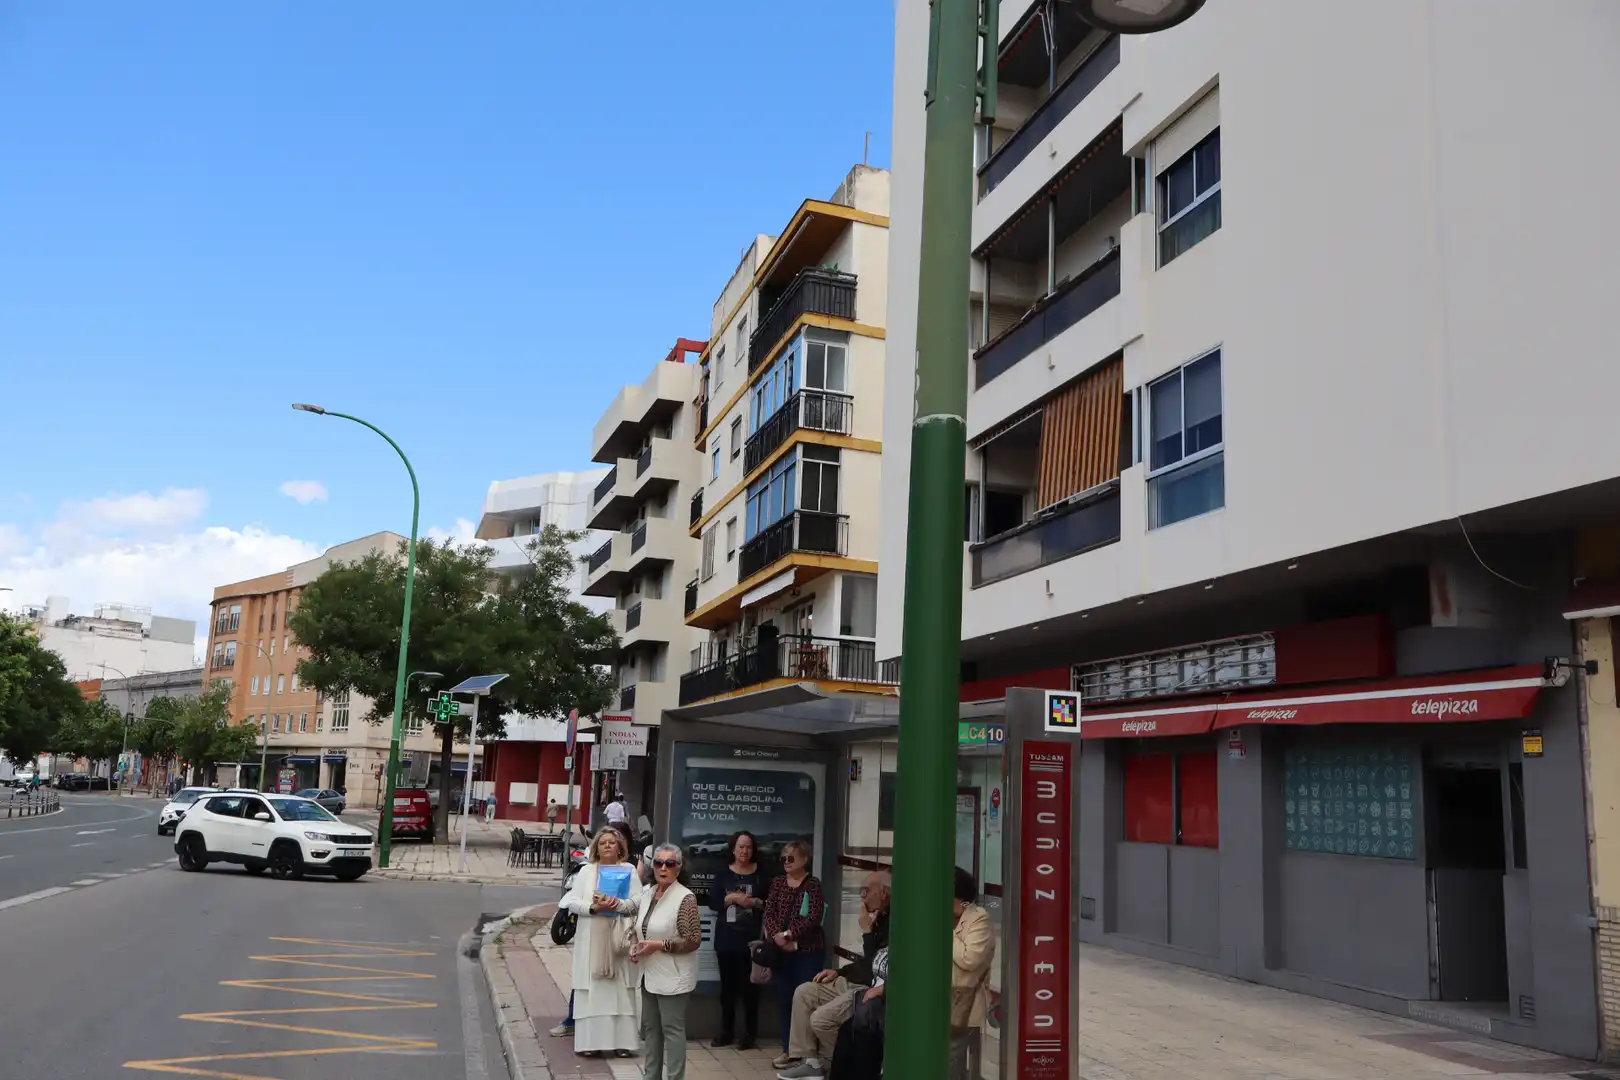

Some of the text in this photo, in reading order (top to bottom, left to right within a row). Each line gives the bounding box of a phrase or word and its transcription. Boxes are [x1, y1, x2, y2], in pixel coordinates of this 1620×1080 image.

[1411, 698, 1478, 720] telepizza
[1247, 709, 1298, 723] telepizza
[1122, 720, 1157, 735] telepizza
[969, 727, 986, 740] C4
[987, 727, 1004, 742] 10
[692, 783, 776, 793] QUE EL PRECIO
[710, 793, 725, 801] LA
[727, 794, 784, 803] GASOLINA
[710, 803, 772, 813] CONTROLE
[691, 812, 706, 820] TU
